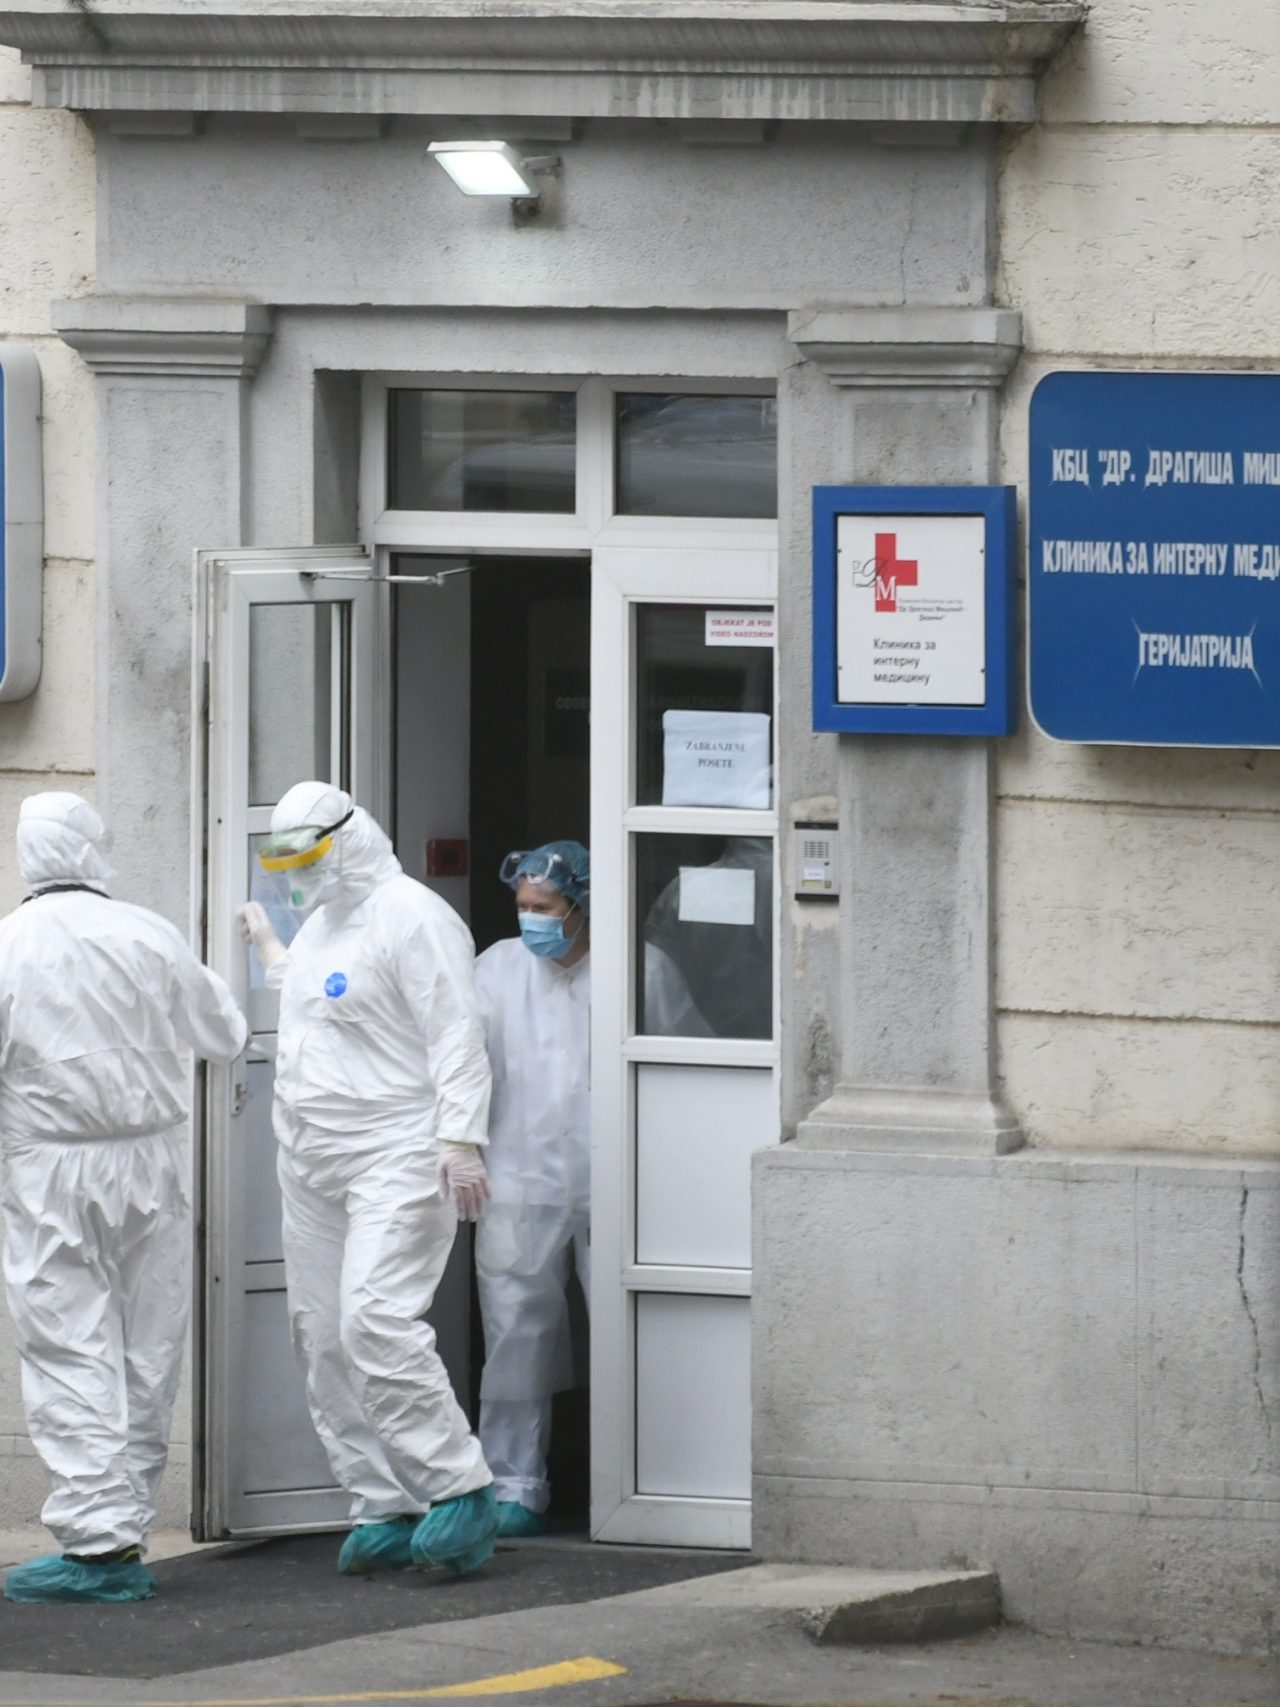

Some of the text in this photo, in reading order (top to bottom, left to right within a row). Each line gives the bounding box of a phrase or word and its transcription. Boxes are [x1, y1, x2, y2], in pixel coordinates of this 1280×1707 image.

[1051, 449, 1090, 487] КБЦ
[1144, 450, 1234, 487] ДРАГИША
[1042, 540, 1124, 575] КЛИНИКА
[1125, 541, 1149, 574] ЗА
[1153, 542, 1228, 576] ИНТЕРНУ
[873, 638, 936, 650] Клиника за
[1138, 634, 1253, 668] ГЕРИЈАТРИЈА
[873, 656, 920, 670] интерну
[873, 673, 931, 687] медицину
